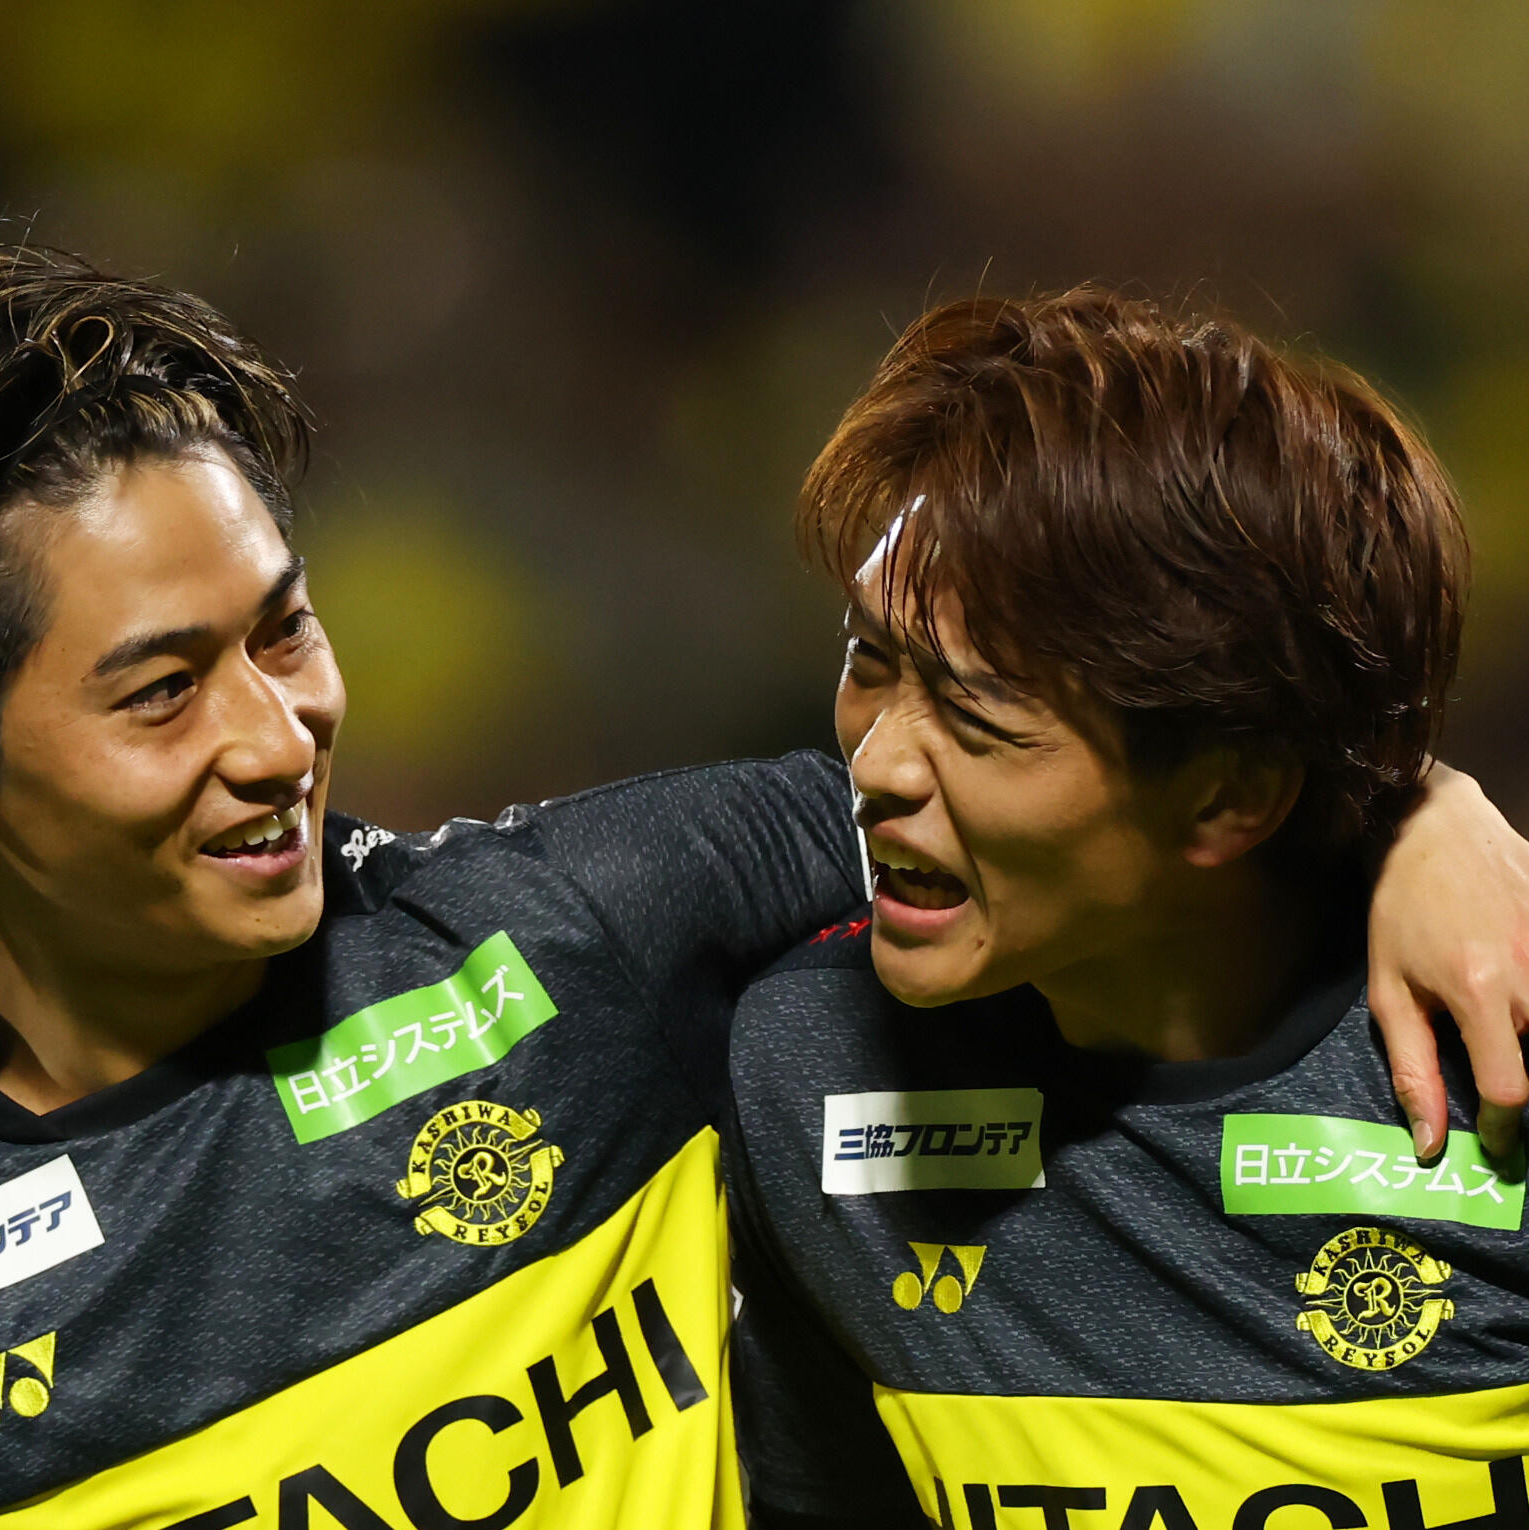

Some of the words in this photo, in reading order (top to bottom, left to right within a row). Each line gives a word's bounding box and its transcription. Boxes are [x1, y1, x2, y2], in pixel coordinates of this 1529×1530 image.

[287, 964, 525, 1114] 日立システムズ
[412, 1103, 512, 1174] KASHIWA
[833, 1121, 1033, 1161] 三協フロンテア
[454, 1180, 549, 1243] REYSOL
[1313, 1228, 1427, 1278] KASHIWA
[1323, 1327, 1432, 1368] REYSOL
